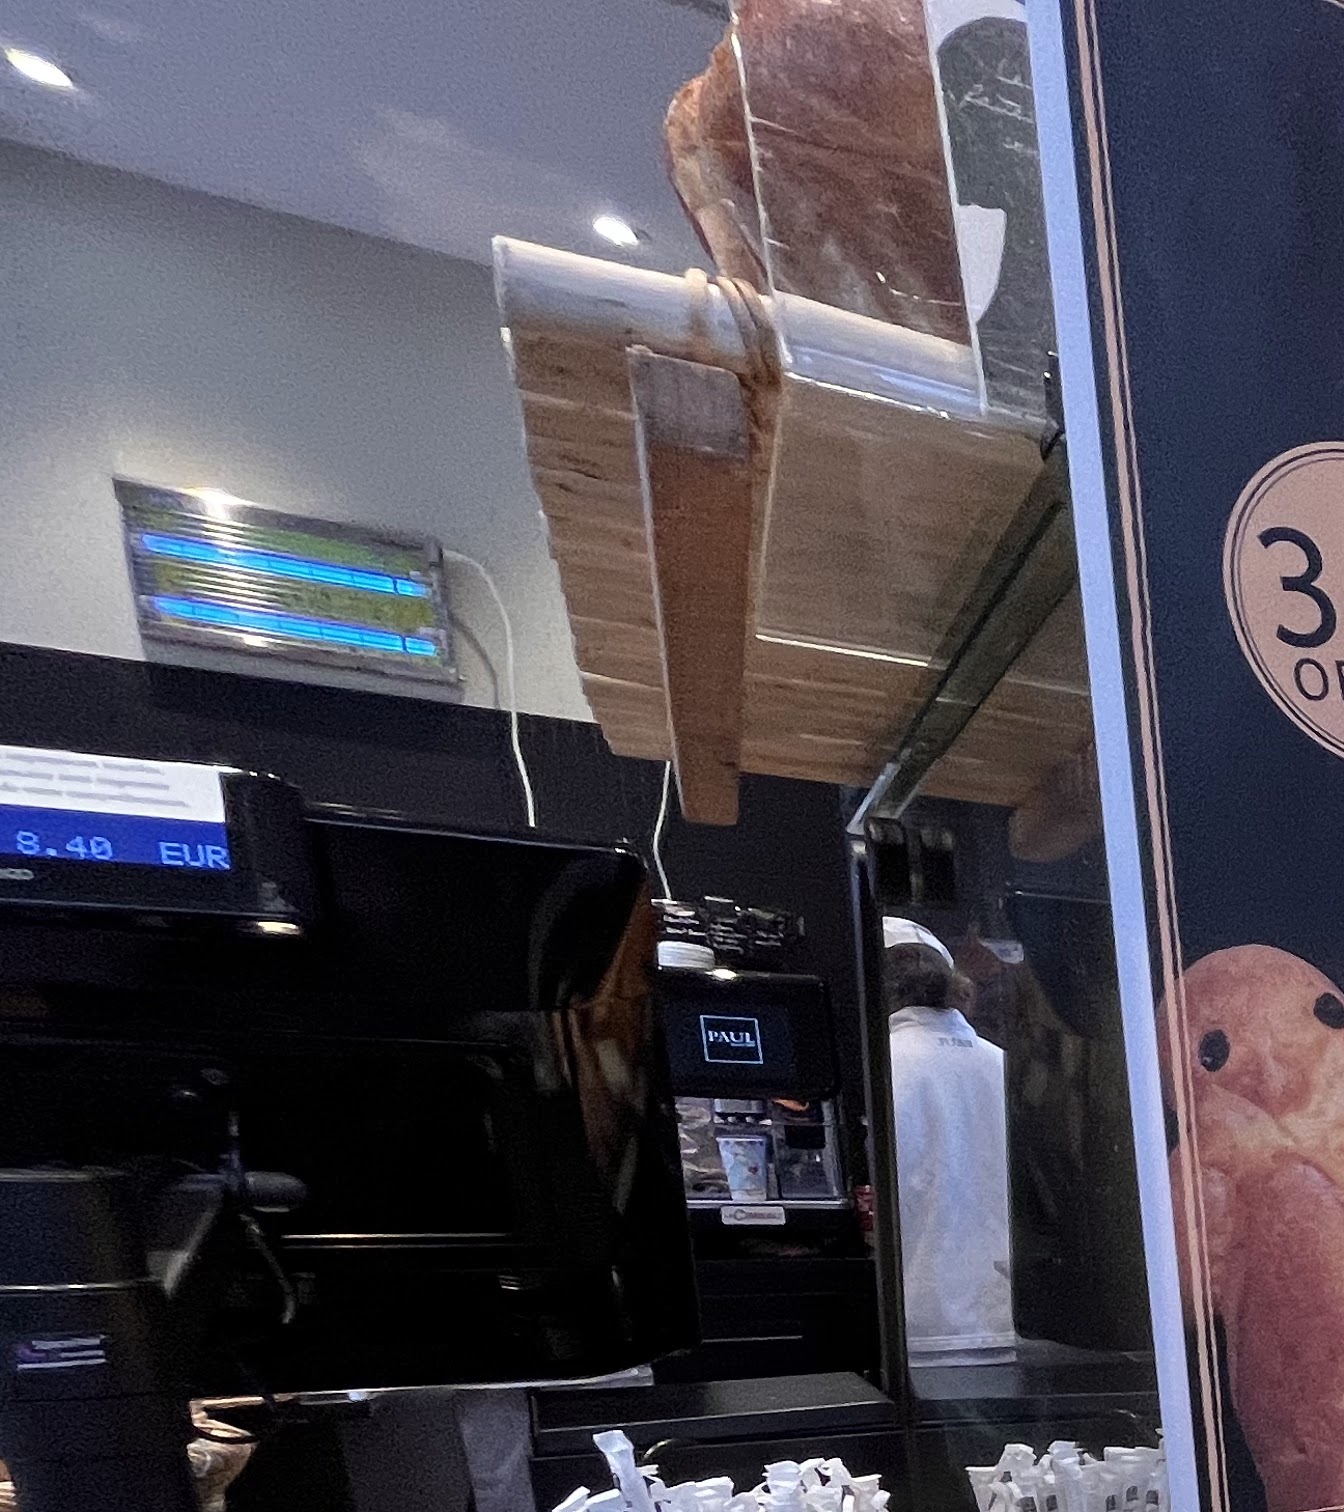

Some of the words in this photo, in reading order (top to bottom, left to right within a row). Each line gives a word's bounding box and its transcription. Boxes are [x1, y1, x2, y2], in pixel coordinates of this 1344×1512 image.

[16, 830, 113, 860] 8.40
[158, 841, 231, 871] EUR
[707, 1030, 756, 1043] PAUL
